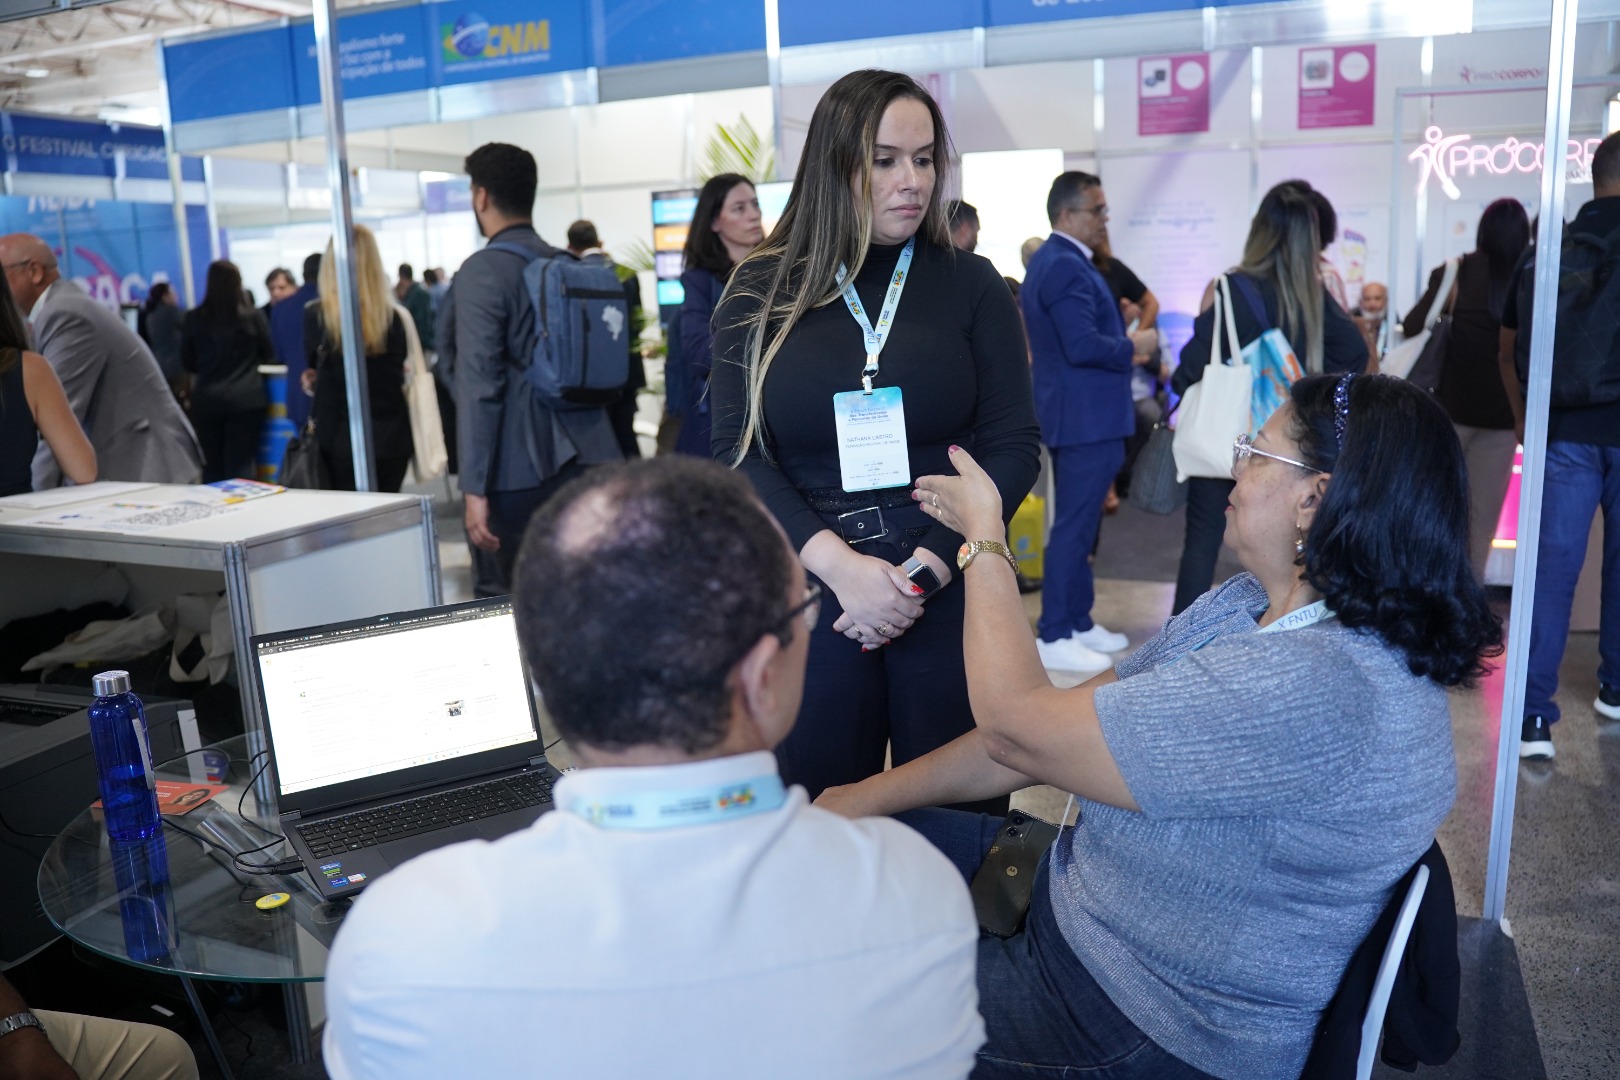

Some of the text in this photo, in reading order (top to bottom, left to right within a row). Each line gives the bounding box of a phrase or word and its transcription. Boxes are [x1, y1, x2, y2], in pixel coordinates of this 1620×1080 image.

[485, 20, 549, 58] CNM
[19, 136, 98, 160] FESTIVAL
[1278, 607, 1317, 630] X FNTU
